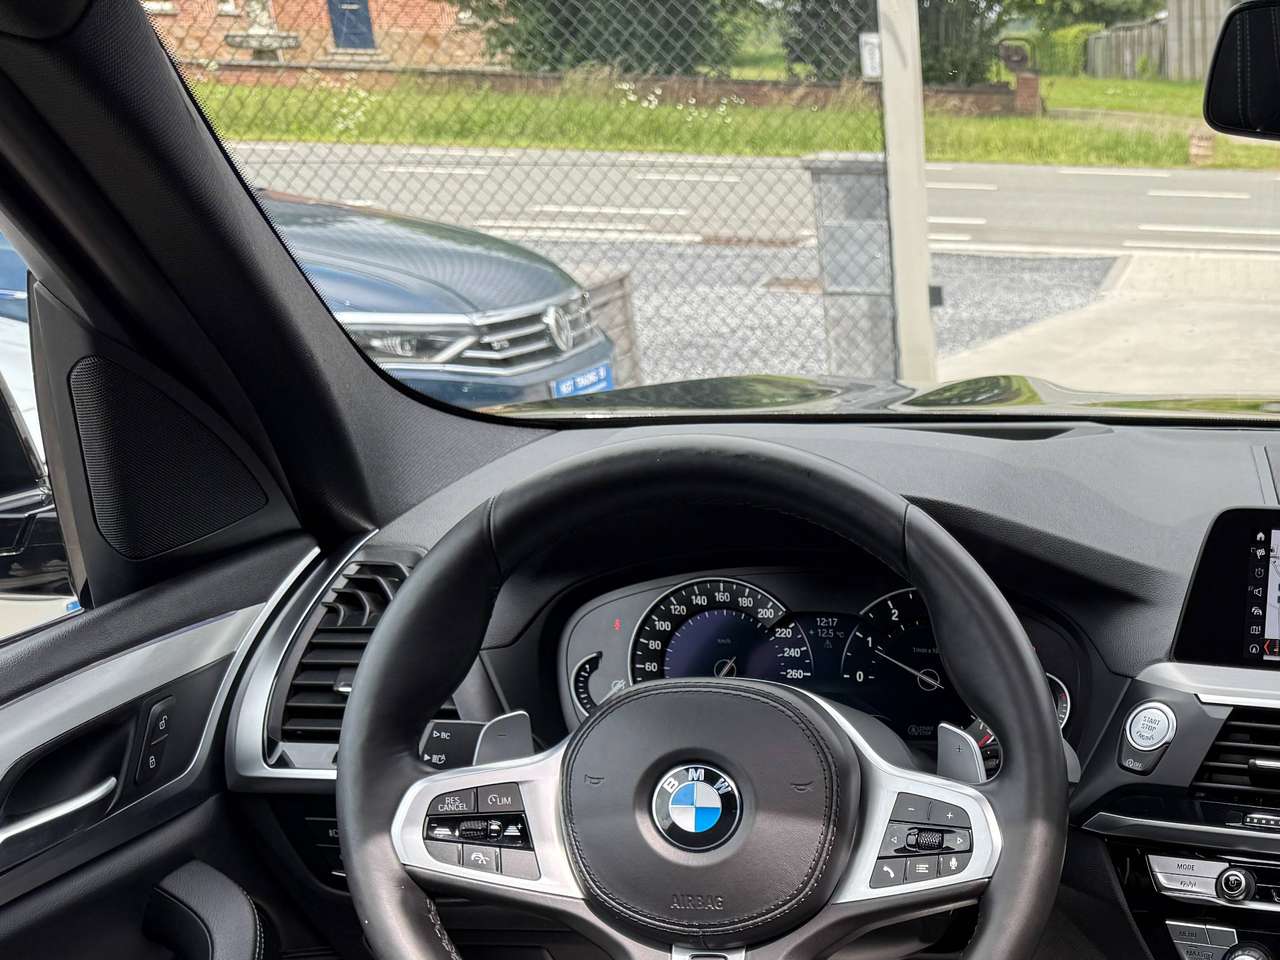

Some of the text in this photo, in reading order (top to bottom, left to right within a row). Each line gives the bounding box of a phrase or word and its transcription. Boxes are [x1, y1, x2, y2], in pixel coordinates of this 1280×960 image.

[692, 595, 708, 606] 140
[714, 592, 731, 602] 160
[738, 597, 754, 608] 180
[670, 605, 687, 616] 120
[757, 608, 775, 619] 200
[891, 609, 899, 621] 2
[654, 621, 672, 631] 100
[816, 617, 838, 627] 12:17
[775, 628, 793, 638] 220
[648, 640, 662, 650] 80
[867, 636, 872, 647] 1
[783, 649, 801, 659] 240
[644, 662, 658, 672] 60
[786, 670, 804, 680] 260
[856, 671, 864, 682] 0
[441, 732, 451, 740] BC
[664, 768, 731, 795] BMW
[445, 796, 461, 804] RES
[438, 804, 468, 812] CANCEL
[1177, 863, 1195, 871] MODE
[670, 895, 724, 911] AIRBAG
